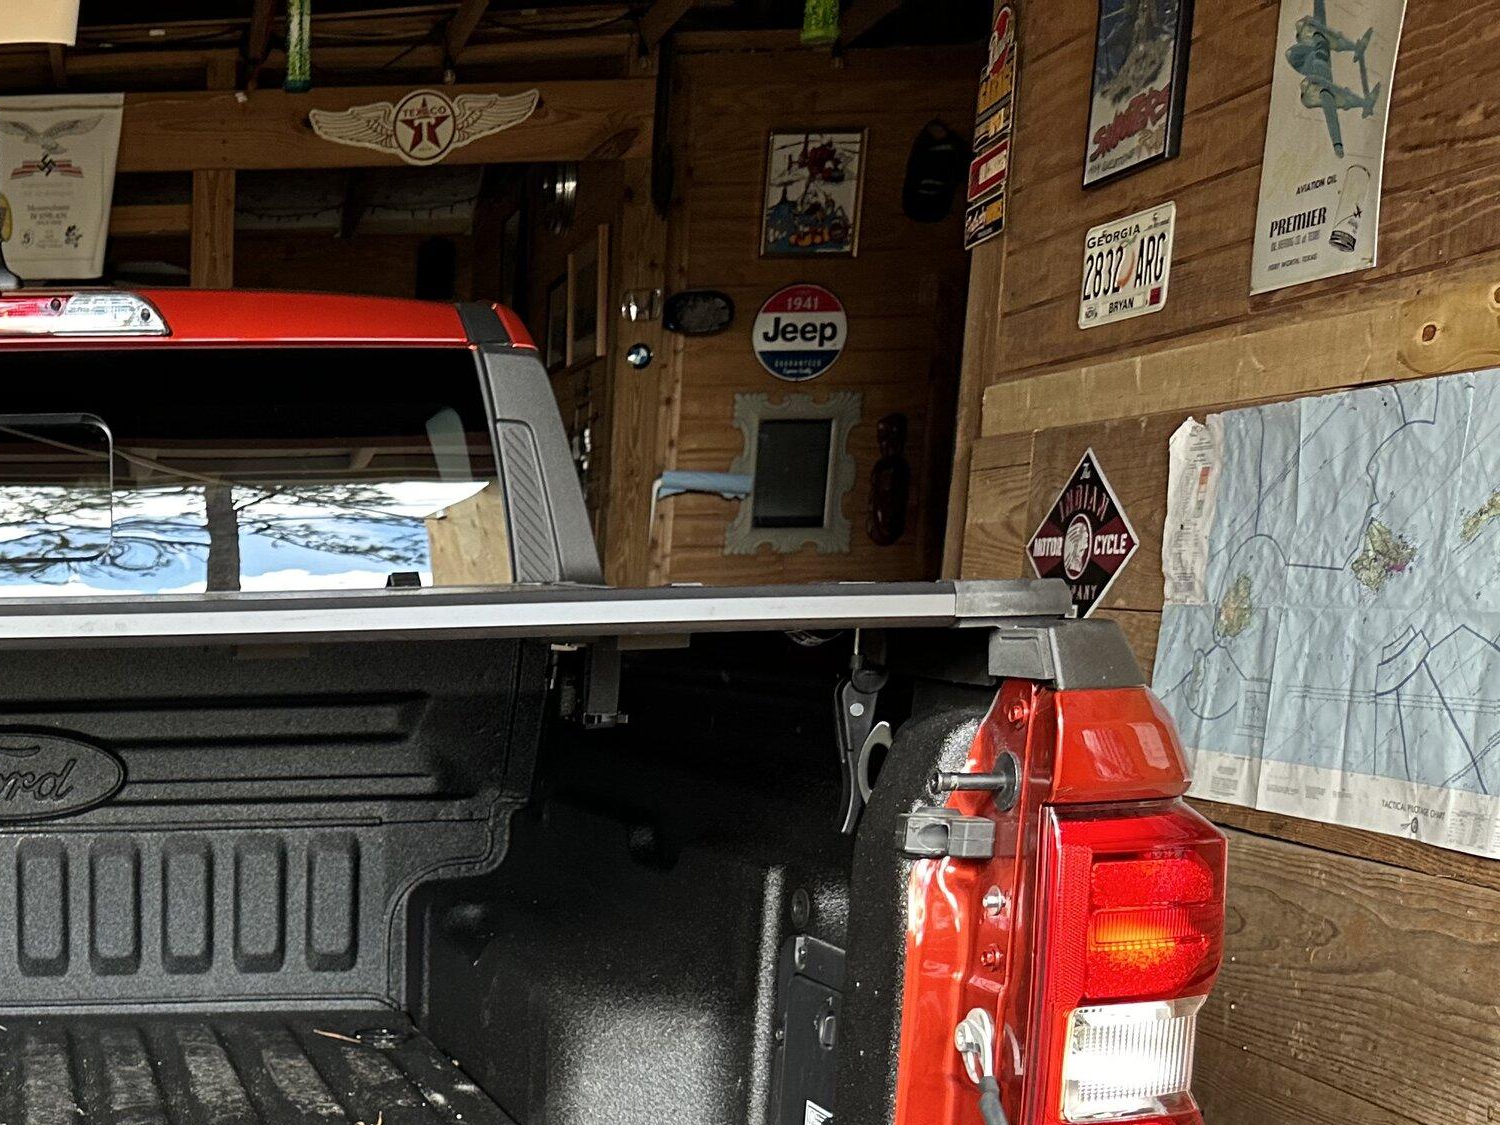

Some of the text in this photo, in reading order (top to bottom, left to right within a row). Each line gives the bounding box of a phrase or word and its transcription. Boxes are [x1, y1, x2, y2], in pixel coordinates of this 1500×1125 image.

[1268, 206, 1327, 239] PREMIER
[1086, 223, 1141, 250] GEORGIA
[1082, 245, 1124, 301] 2832
[786, 296, 819, 311] 1941
[1108, 297, 1135, 315] BRYAN
[762, 316, 838, 348] Jeep
[1032, 533, 1128, 557] MOTOR CYCLE
[1381, 799, 1407, 812] TACTICAL
